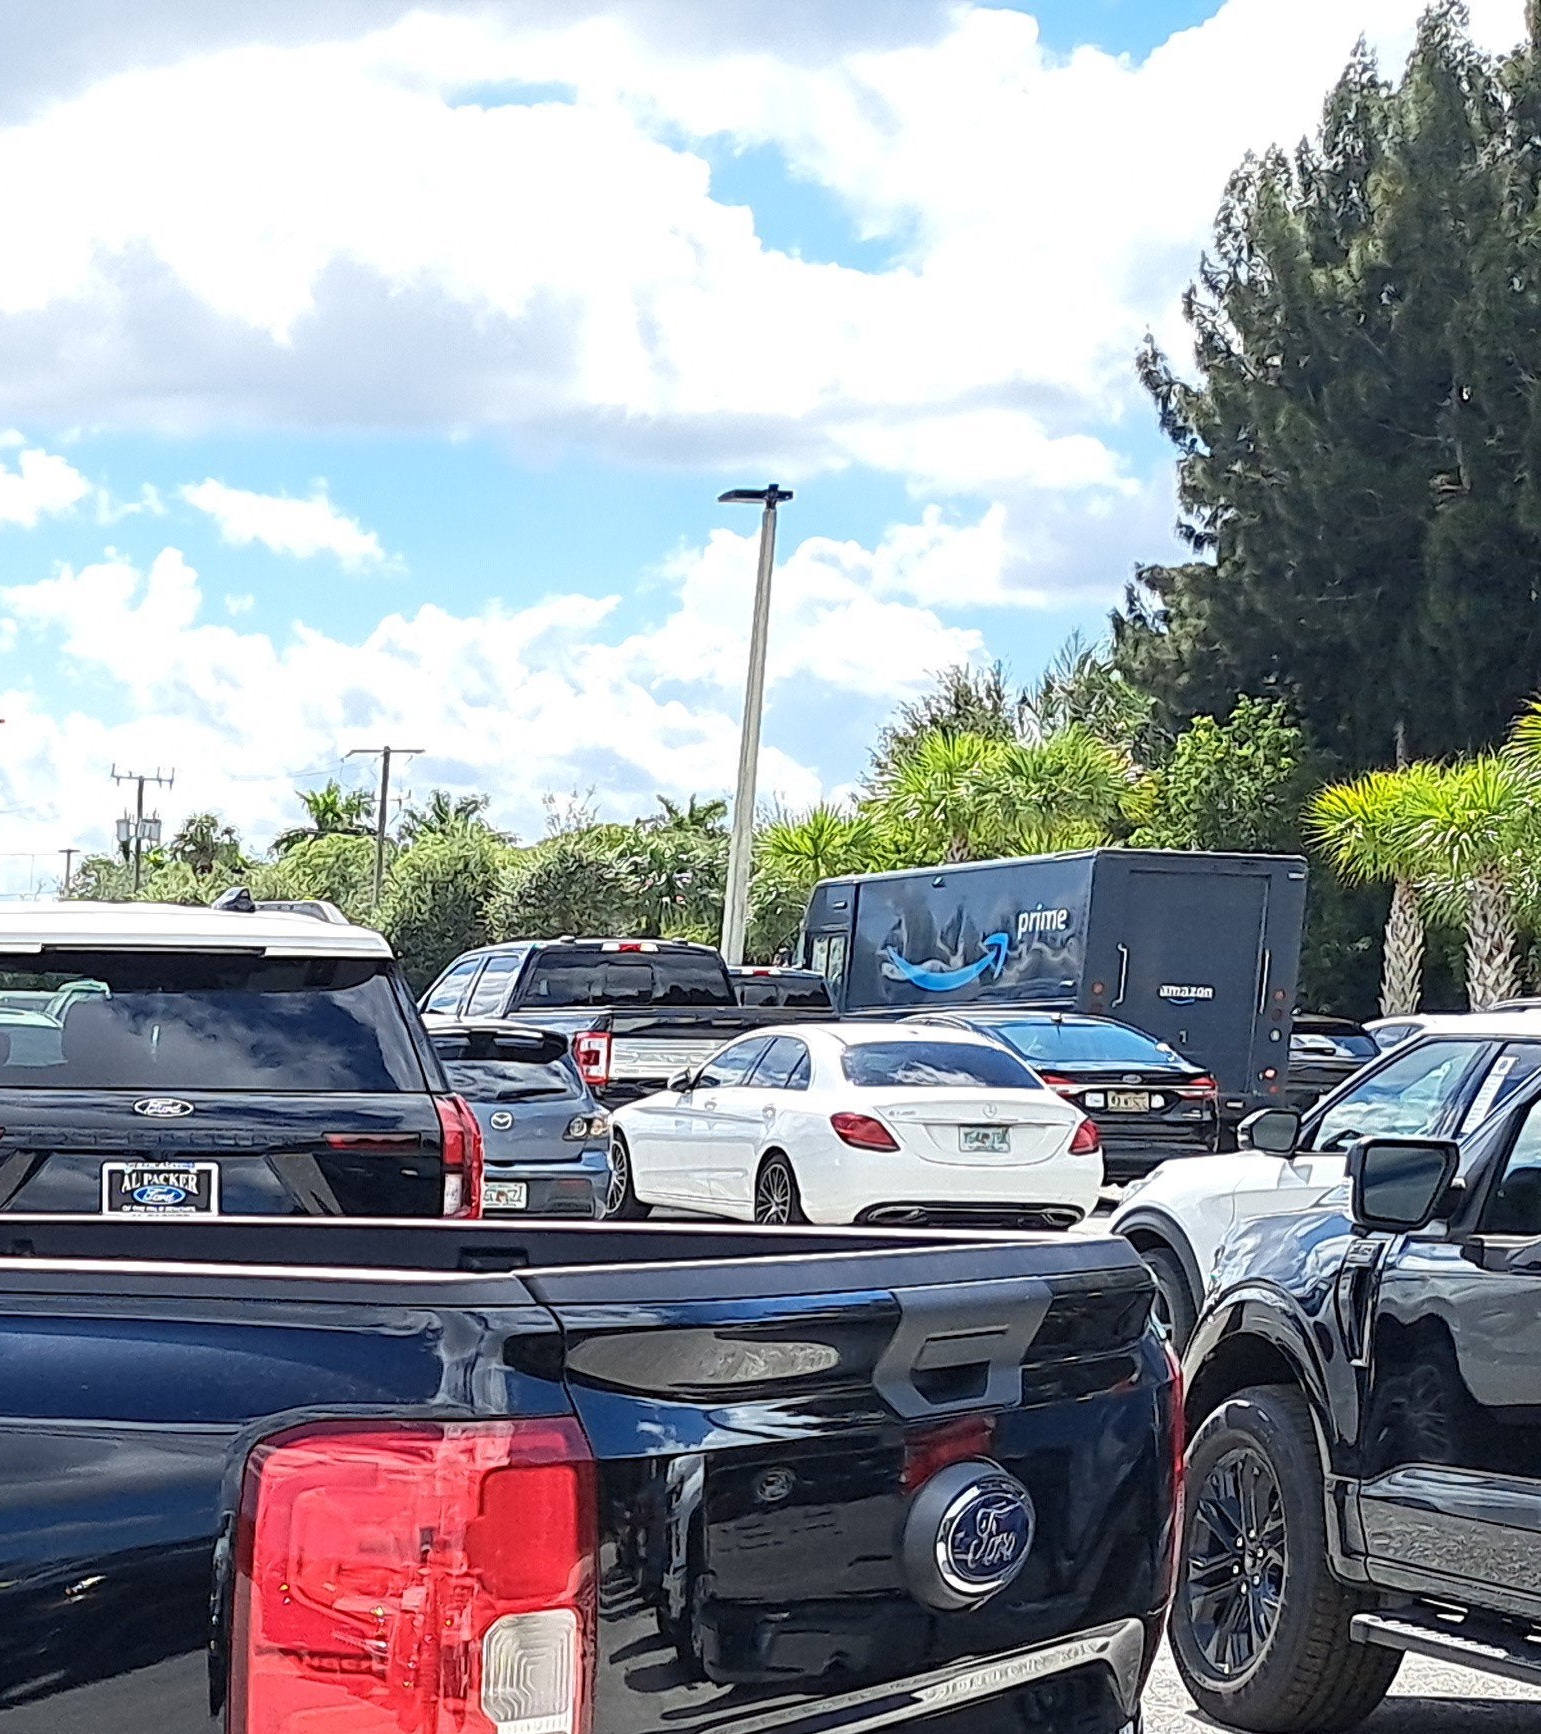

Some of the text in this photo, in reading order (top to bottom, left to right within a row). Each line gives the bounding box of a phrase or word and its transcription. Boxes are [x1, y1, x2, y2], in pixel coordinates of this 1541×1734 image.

[1017, 903, 1068, 940] prime
[1159, 984, 1214, 999] amazon
[122, 1172, 199, 1195] AL PACKER
[961, 1497, 1023, 1572] Ford
